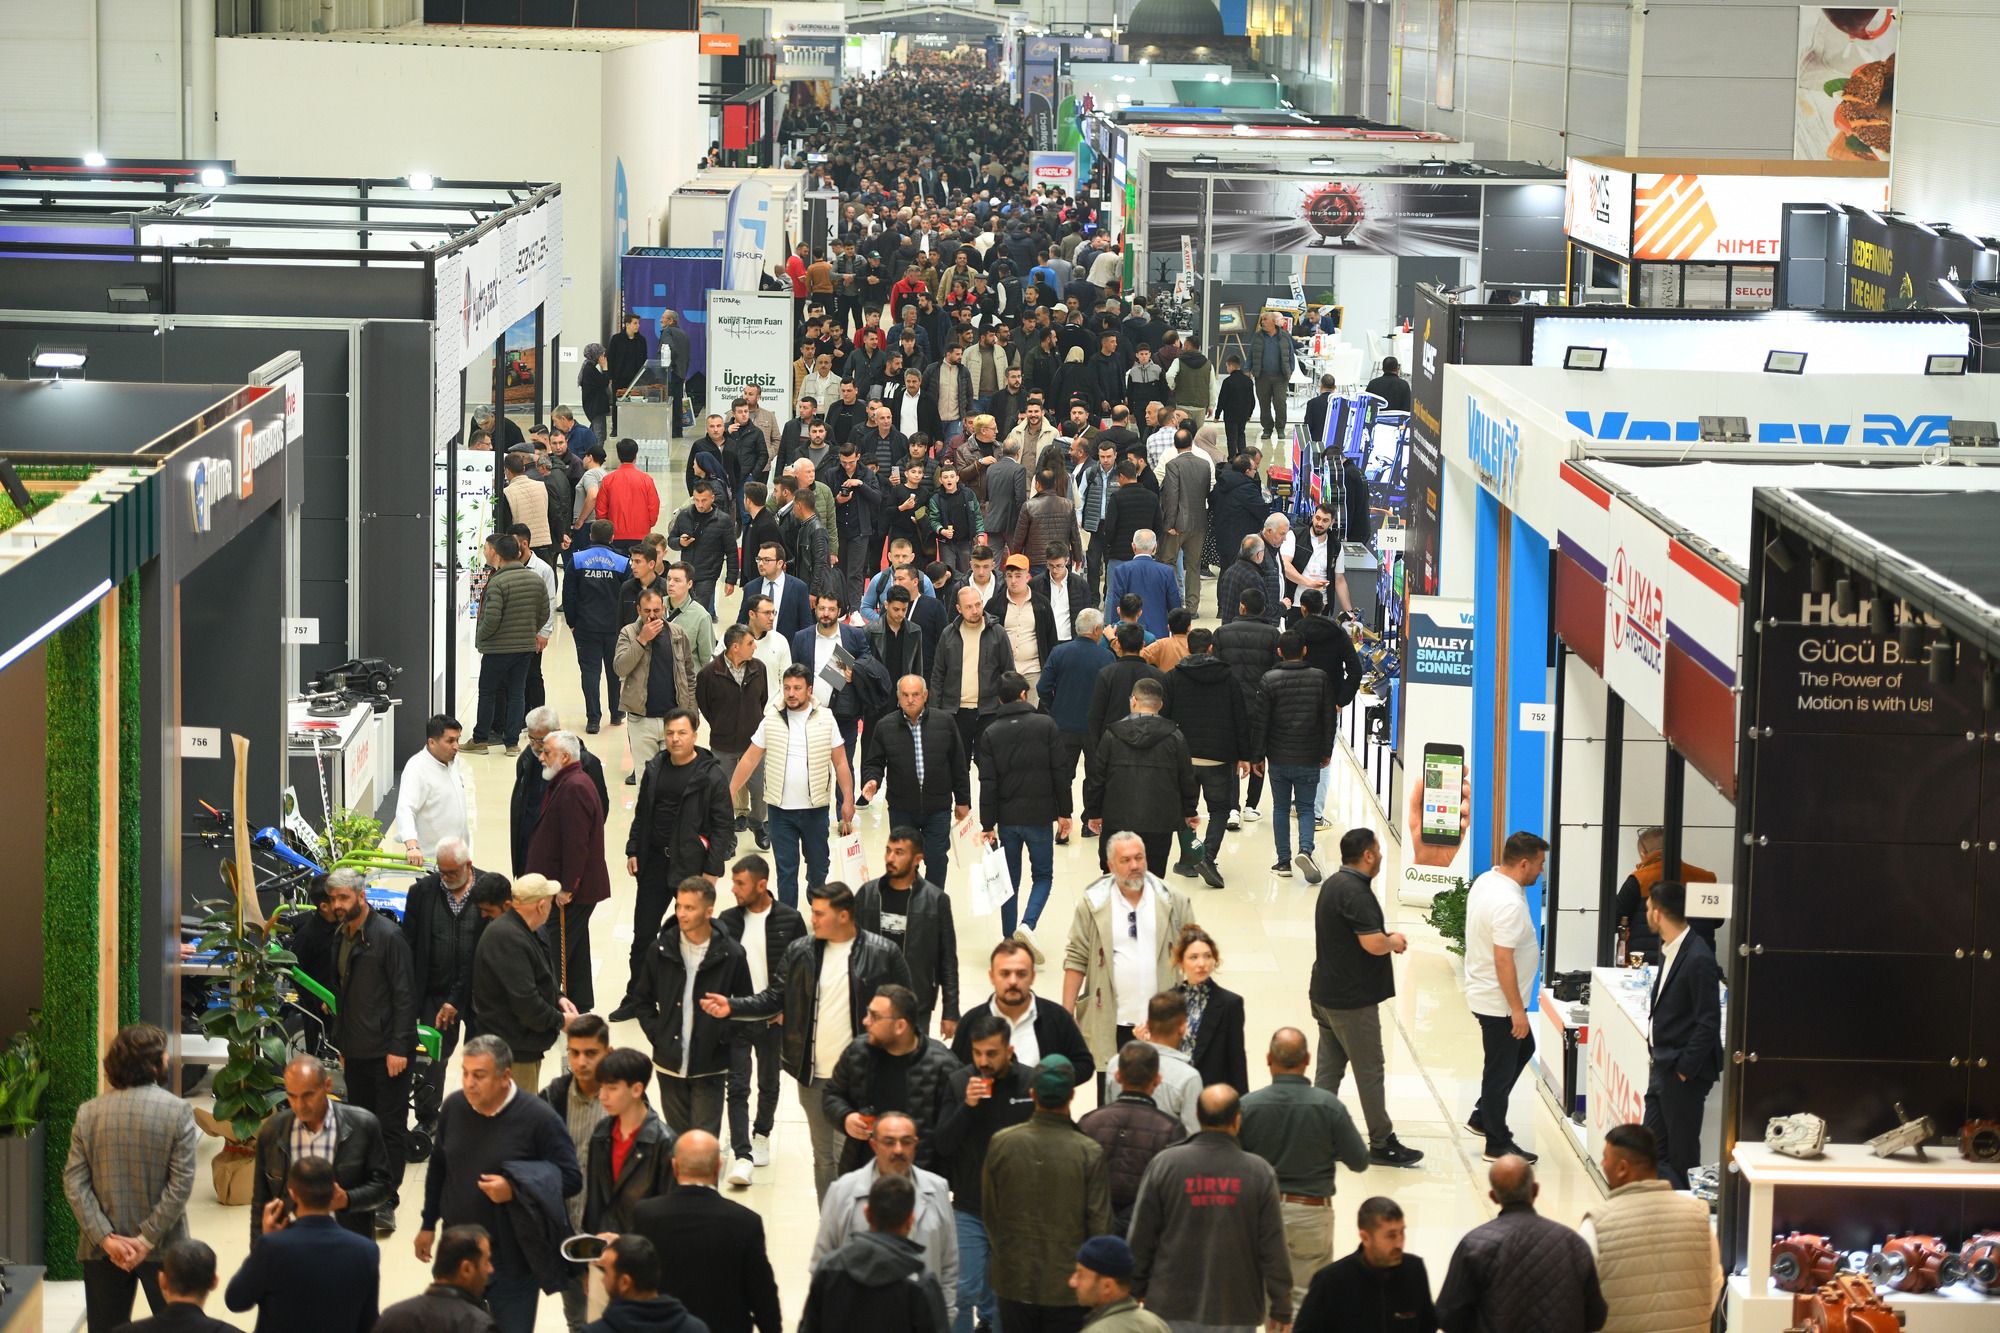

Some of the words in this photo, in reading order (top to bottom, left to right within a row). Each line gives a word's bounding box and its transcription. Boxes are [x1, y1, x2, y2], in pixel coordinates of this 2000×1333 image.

[782, 45, 836, 53] FUTURE
[1852, 238, 1894, 277] REDEFINING
[1735, 287, 1773, 297] SELÇU
[1850, 276, 1865, 307] THE
[1863, 280, 1886, 312] GAME
[718, 317, 741, 327] Konya
[742, 317, 763, 325] Tarım
[764, 318, 783, 326] Fuarı
[723, 369, 776, 386] Ücretsiz
[1467, 394, 1505, 497] VALLEY
[1627, 564, 1664, 639] UYAR
[293, 626, 308, 634] 757
[1416, 636, 1467, 651] VALLEY
[1625, 626, 1662, 676] HYDRAULIC
[1799, 639, 1876, 665] Gücü
[1416, 648, 1465, 663] SMART
[1799, 671, 1829, 687] The
[1832, 672, 1884, 687] Power
[1885, 672, 1903, 688] of
[1797, 695, 1853, 710] Motion
[1856, 695, 1869, 711] is
[1872, 696, 1906, 712] with
[1909, 697, 1934, 712] Us!
[1531, 712, 1547, 721] 752
[191, 737, 208, 747] 756
[1701, 894, 1720, 905] 753
[1184, 1174, 1242, 1194] ZİRVE
